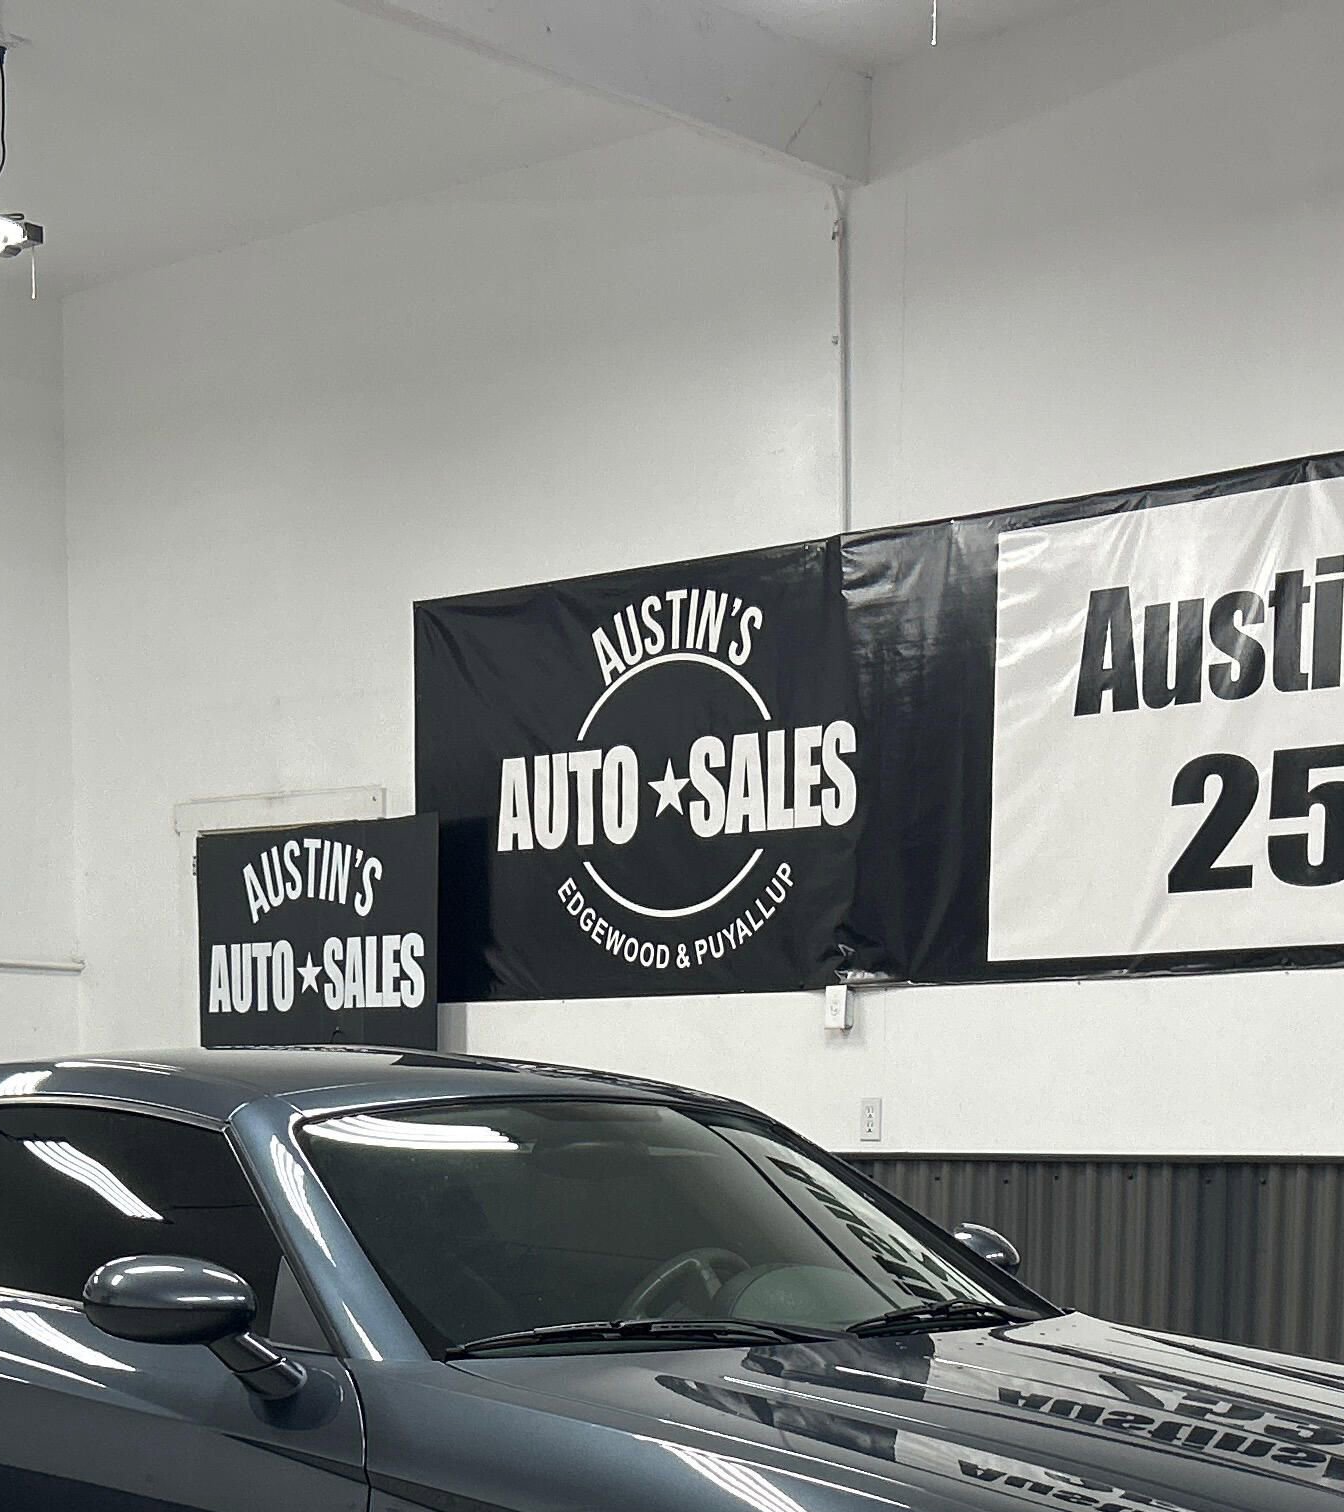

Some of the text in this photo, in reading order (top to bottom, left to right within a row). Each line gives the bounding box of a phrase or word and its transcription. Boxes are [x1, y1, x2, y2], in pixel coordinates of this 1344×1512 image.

[590, 588, 763, 686] AUSTIN'S
[497, 720, 857, 853] AUTO SALES
[242, 838, 383, 924] AUSTIN'S
[557, 862, 795, 969] EDGEWOOD & PUYALLUP
[209, 933, 425, 1014] AUTO SALES
